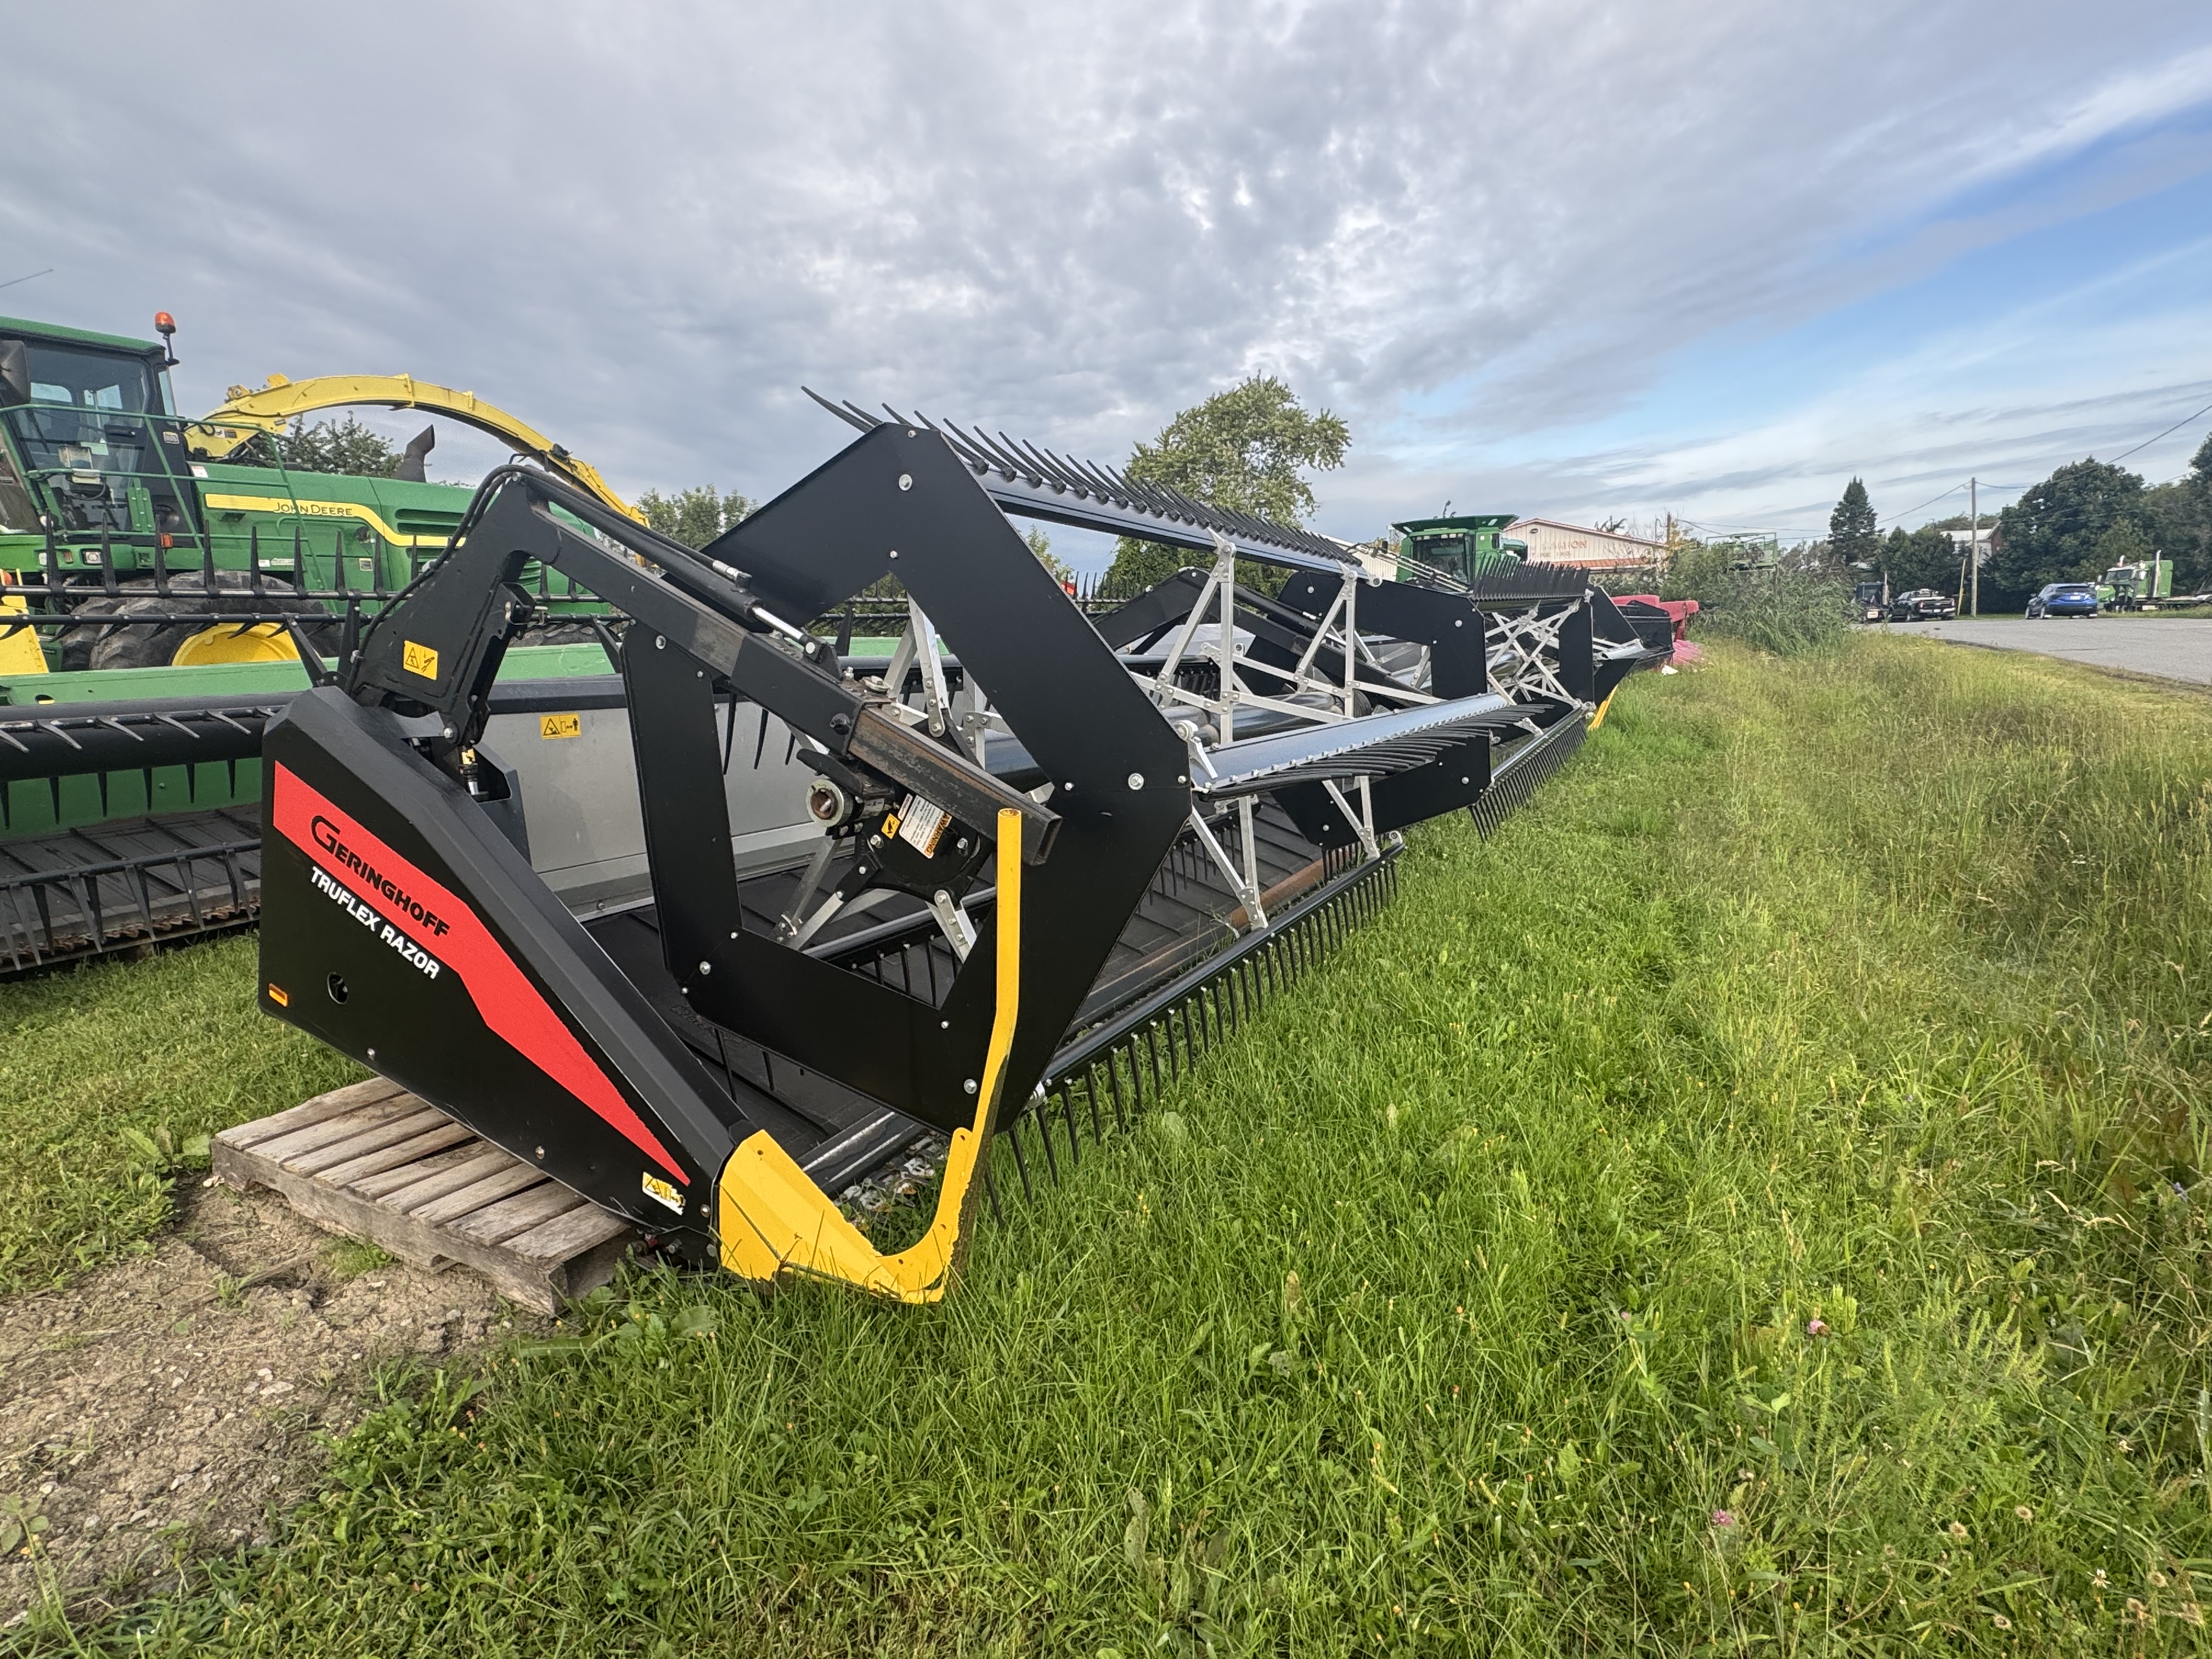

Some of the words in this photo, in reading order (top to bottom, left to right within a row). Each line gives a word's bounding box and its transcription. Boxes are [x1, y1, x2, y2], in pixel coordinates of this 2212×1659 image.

[311, 504, 352, 515] DEERE
[926, 819, 947, 854] WARNING
[311, 815, 450, 936] GERINGHOFF
[311, 866, 380, 932] TRUFLEX
[380, 924, 440, 979] RAZOR
